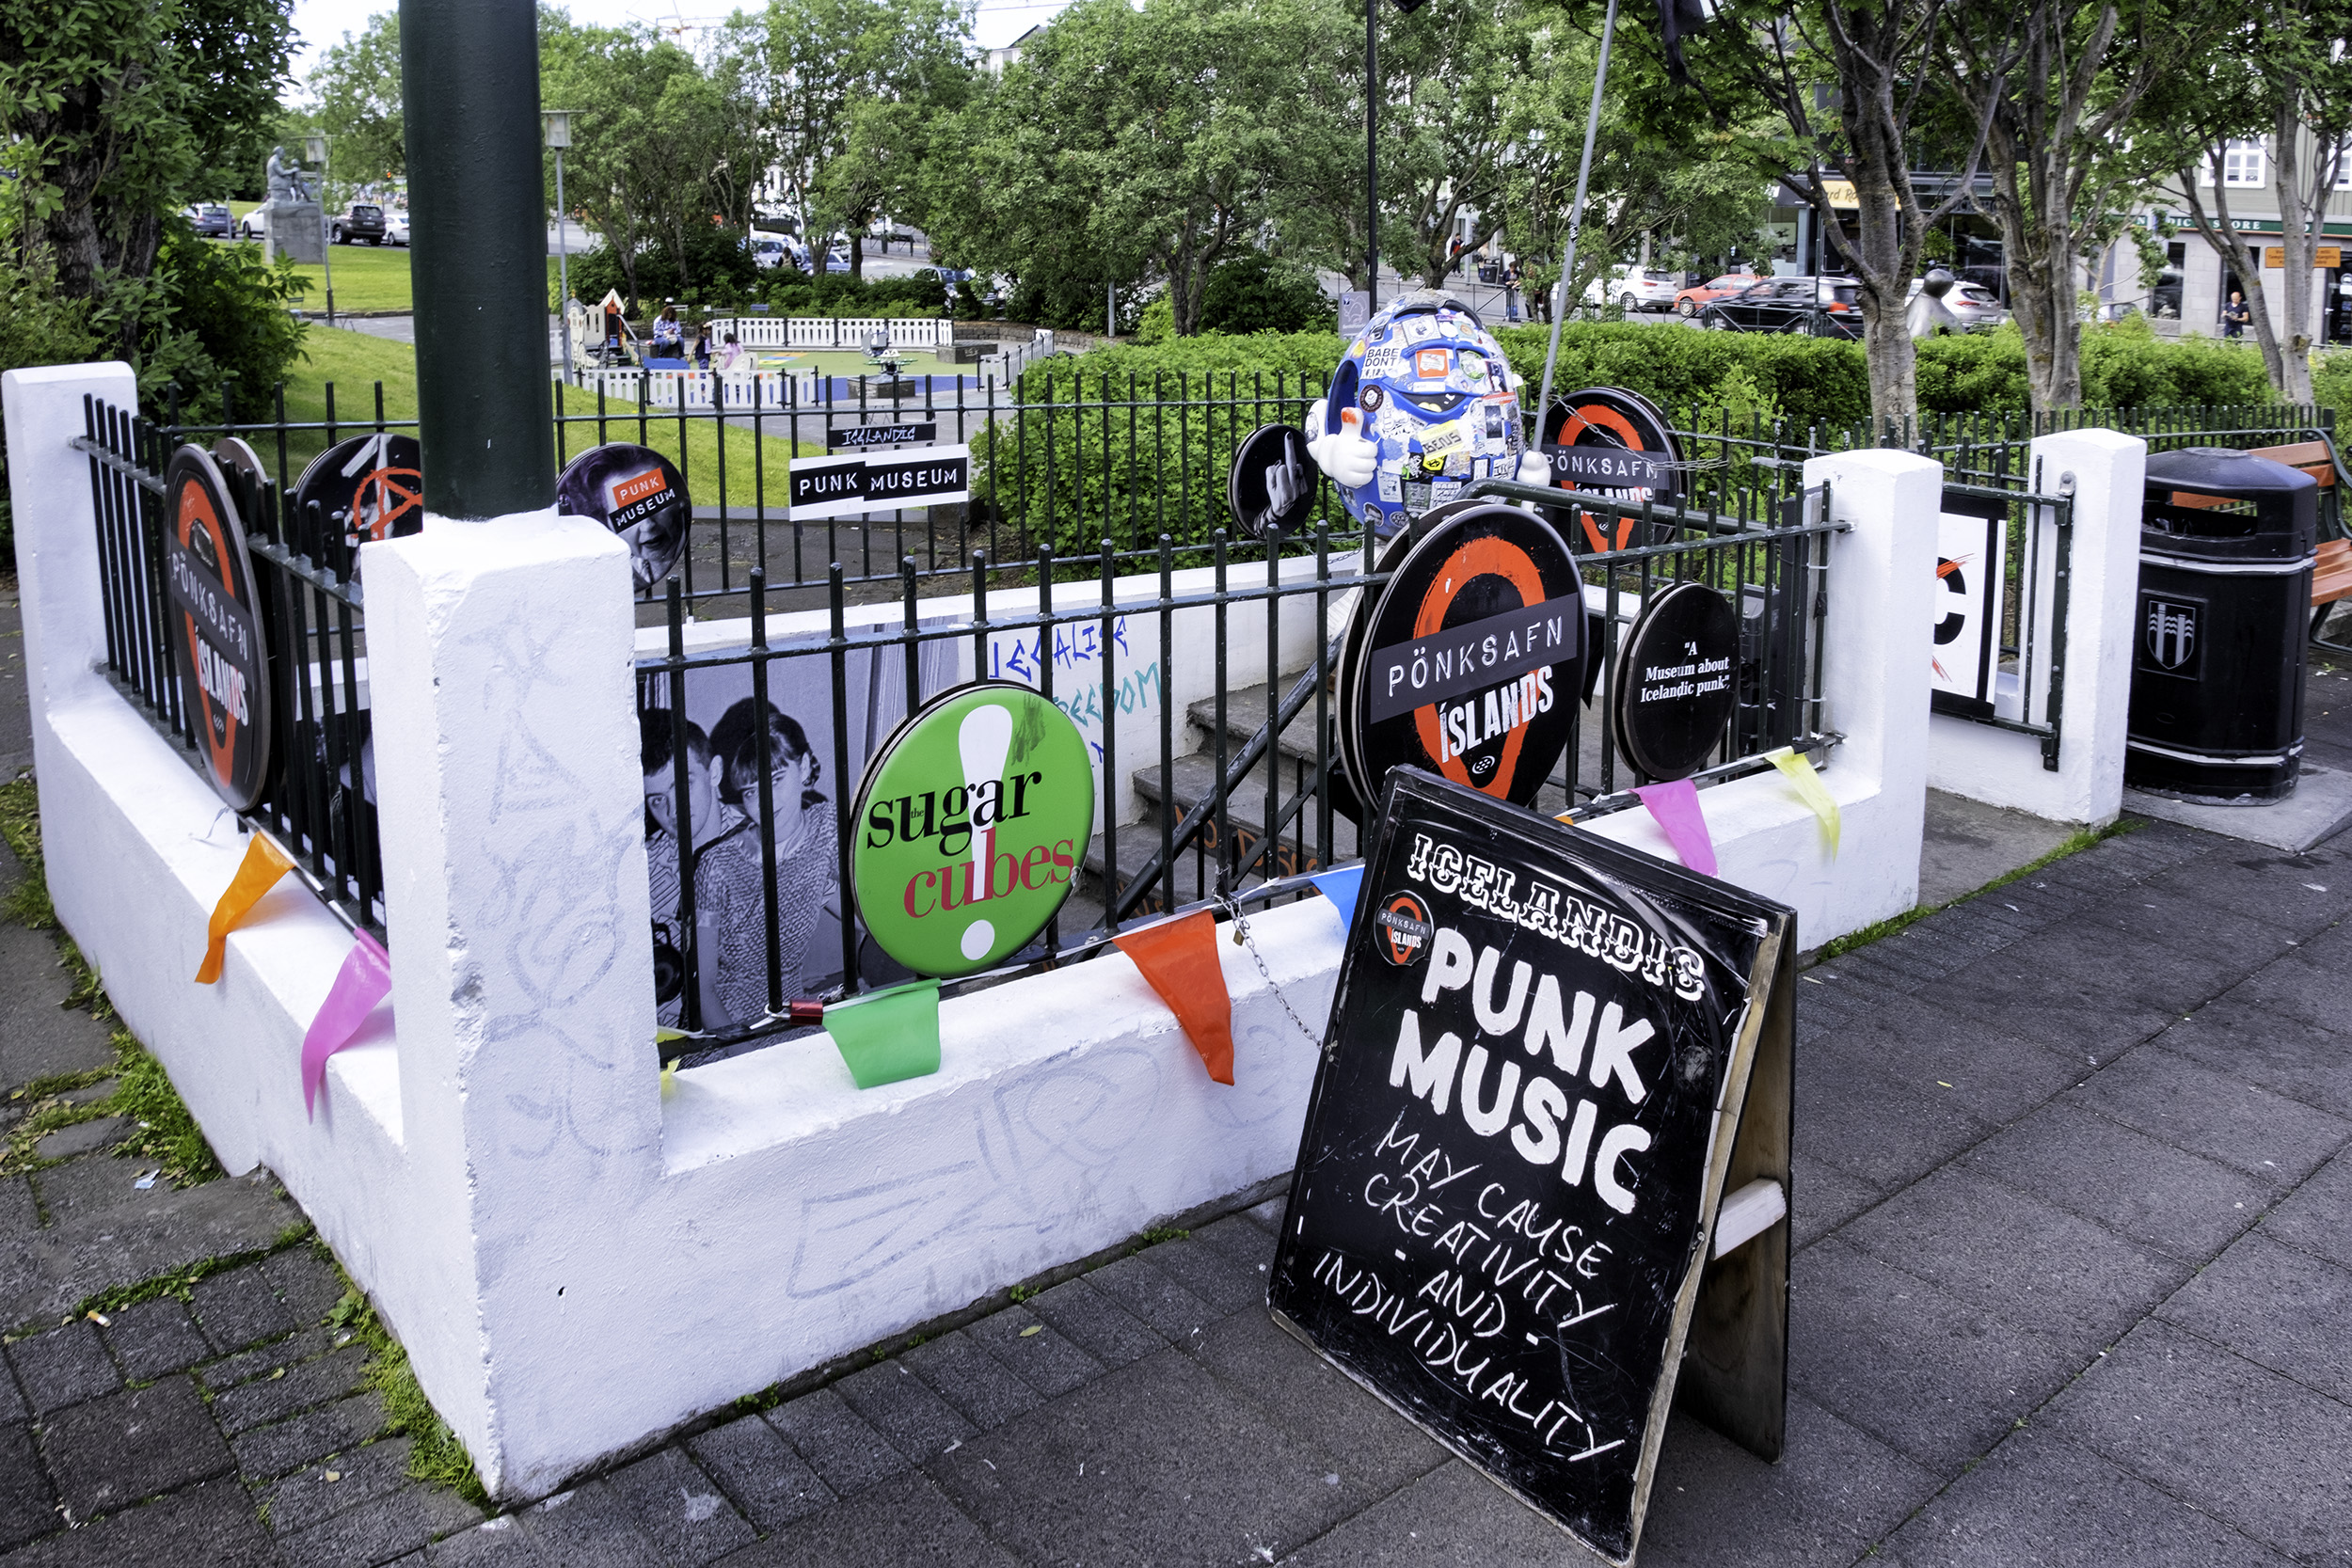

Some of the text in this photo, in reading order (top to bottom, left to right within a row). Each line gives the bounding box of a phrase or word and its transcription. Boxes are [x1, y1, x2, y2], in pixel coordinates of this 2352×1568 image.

[2213, 219, 2260, 230] SORE
[1364, 357, 1398, 367] DONT
[1367, 347, 1399, 358] BABE
[615, 487, 675, 527] MUSEUM
[619, 476, 660, 501] PUNK
[799, 467, 958, 497] PUNK MUSEUM
[171, 550, 248, 662] PÖNKSAFN
[196, 625, 249, 728] ÍSLANDS
[1388, 615, 1563, 697] PÖNKSAFN
[1644, 656, 1730, 683] Museum about
[1438, 664, 1553, 764] ÍSLANDS
[1640, 680, 1695, 703] Icelandic
[866, 770, 1042, 858] sugar
[910, 806, 925, 819] the
[903, 826, 1074, 919] cubes
[1381, 912, 1426, 935] PÖNKSAFN
[1391, 927, 1422, 949] ÍSLANDS
[1422, 927, 1656, 1105] PUNK
[1389, 1008, 1652, 1215] MUSIC
[1375, 1118, 1613, 1278] MAY CAUSE
[1364, 1172, 1617, 1328] CREATIVITY
[1418, 1269, 1506, 1338] AND
[1312, 1252, 1626, 1463] INDIVIDUALITY
